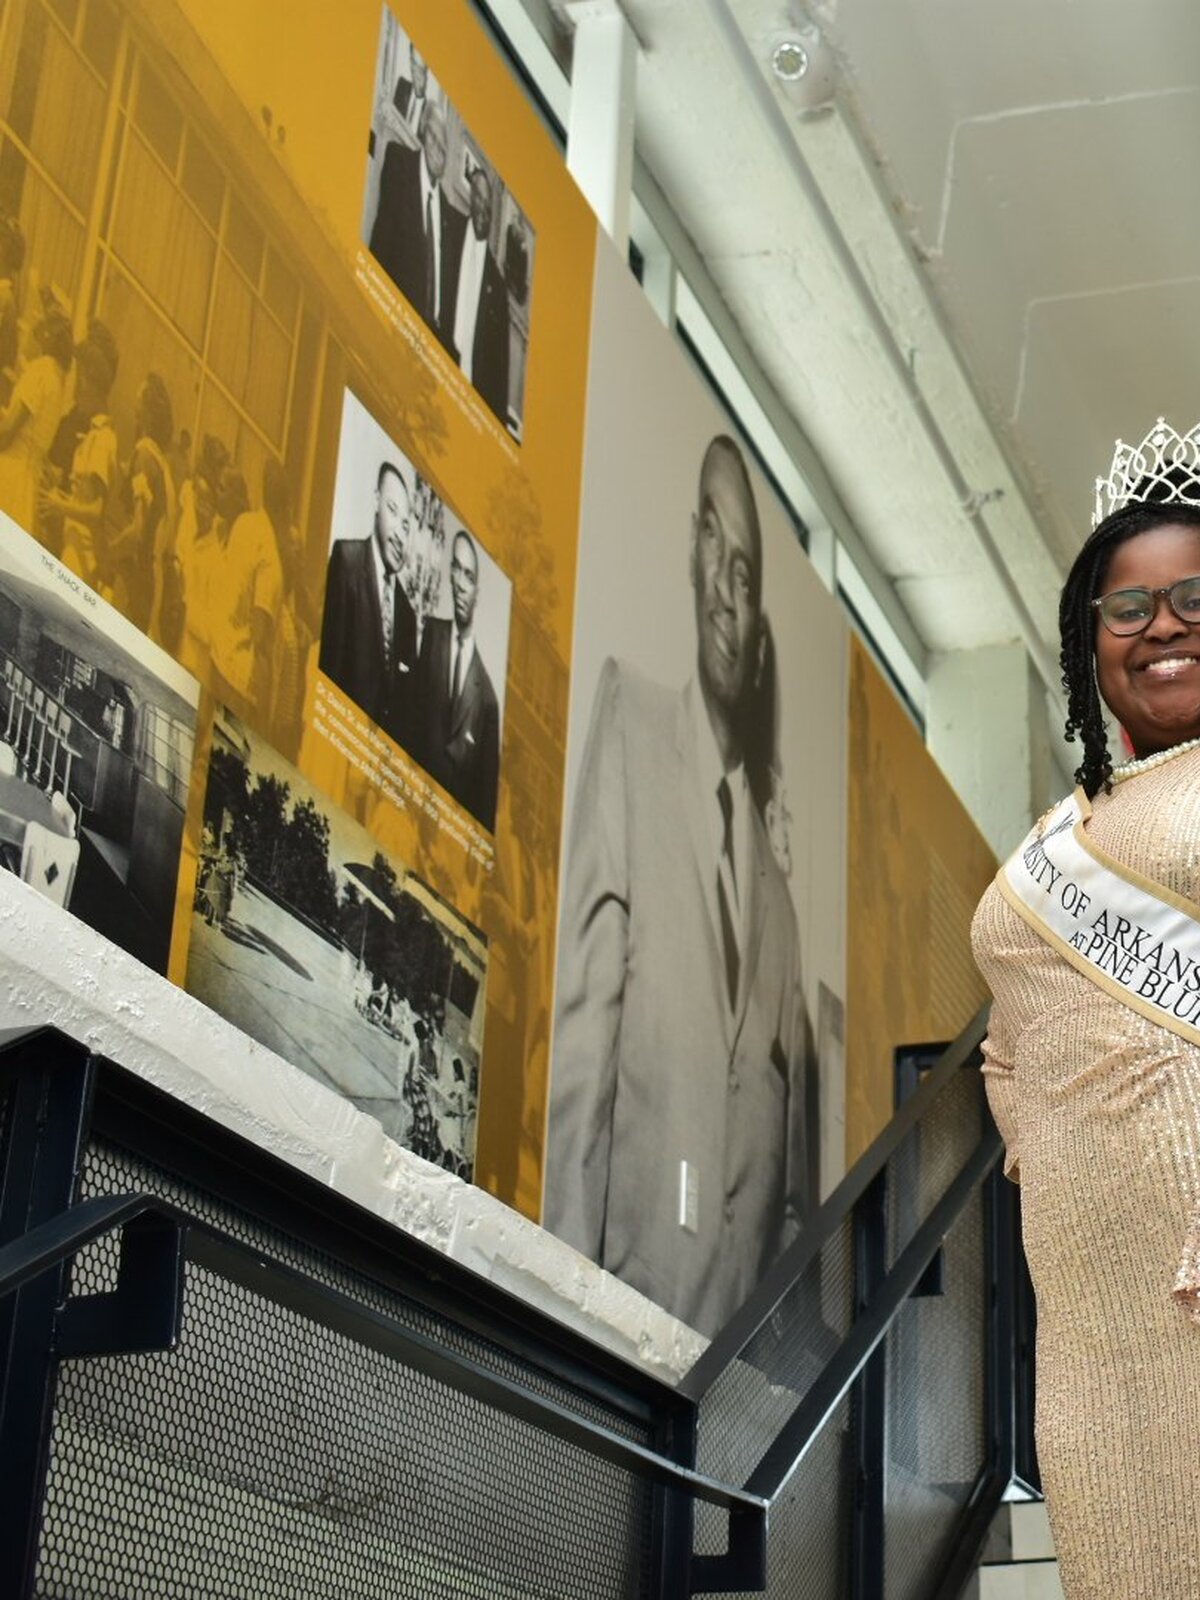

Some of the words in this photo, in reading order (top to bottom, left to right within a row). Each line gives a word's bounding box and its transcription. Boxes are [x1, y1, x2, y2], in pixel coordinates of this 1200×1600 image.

[1061, 883, 1091, 919] OF
[1069, 931, 1089, 950] AT
[1084, 932, 1139, 985] PINE
